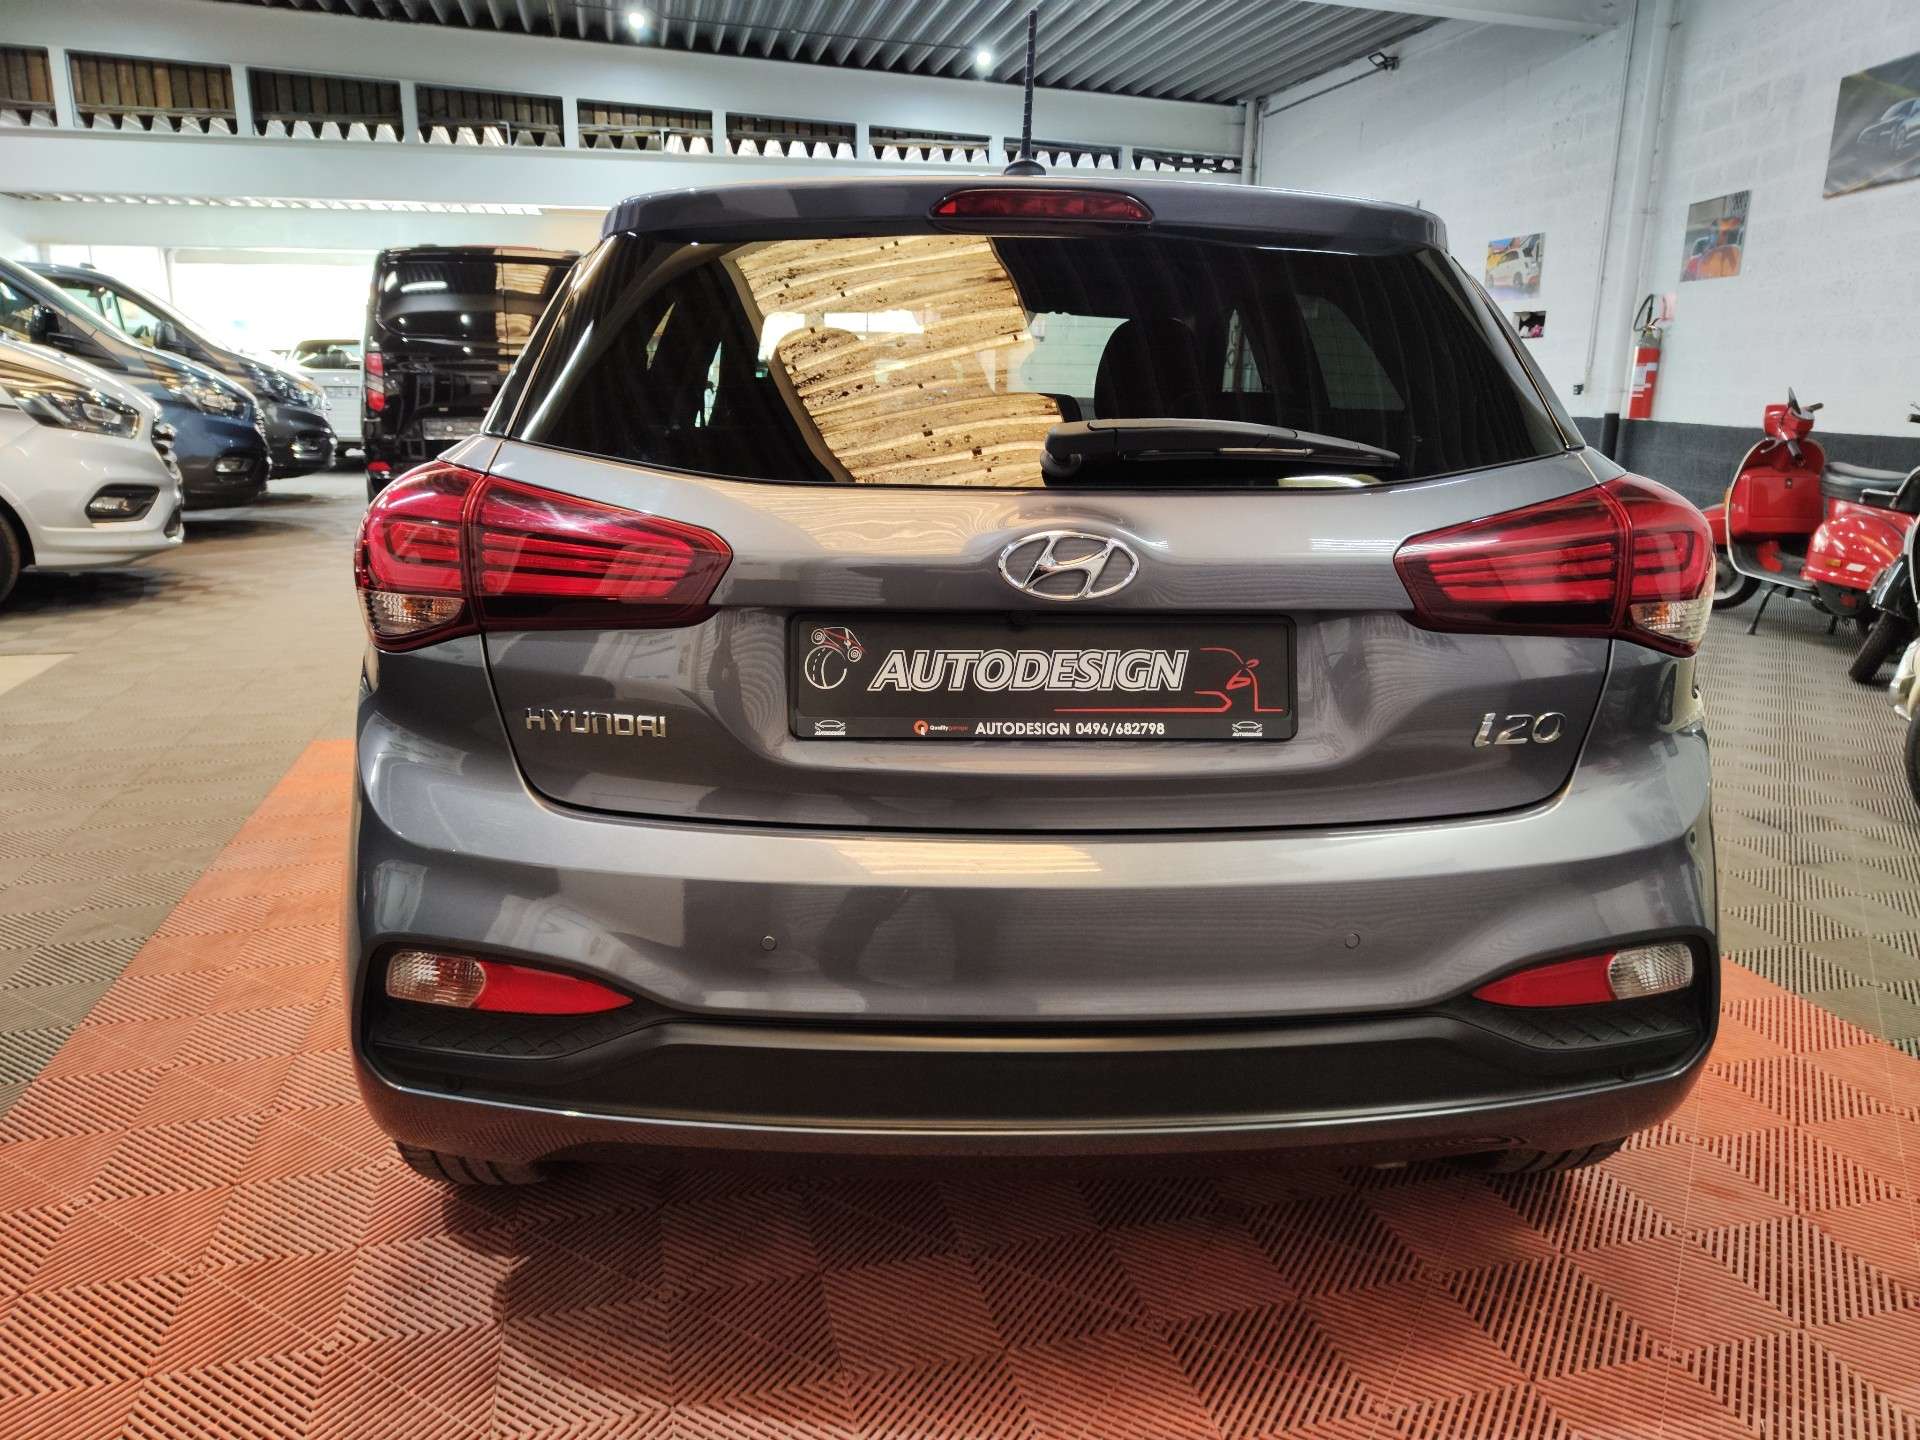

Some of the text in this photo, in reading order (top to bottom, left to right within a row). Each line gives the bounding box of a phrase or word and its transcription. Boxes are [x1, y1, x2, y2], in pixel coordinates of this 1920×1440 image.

[867, 650, 1189, 691] AUTODESIGN
[526, 707, 666, 737] HYUNDAI
[975, 722, 1165, 736] AUTODESIGN 0496/682798
[1474, 711, 1567, 748] i20
